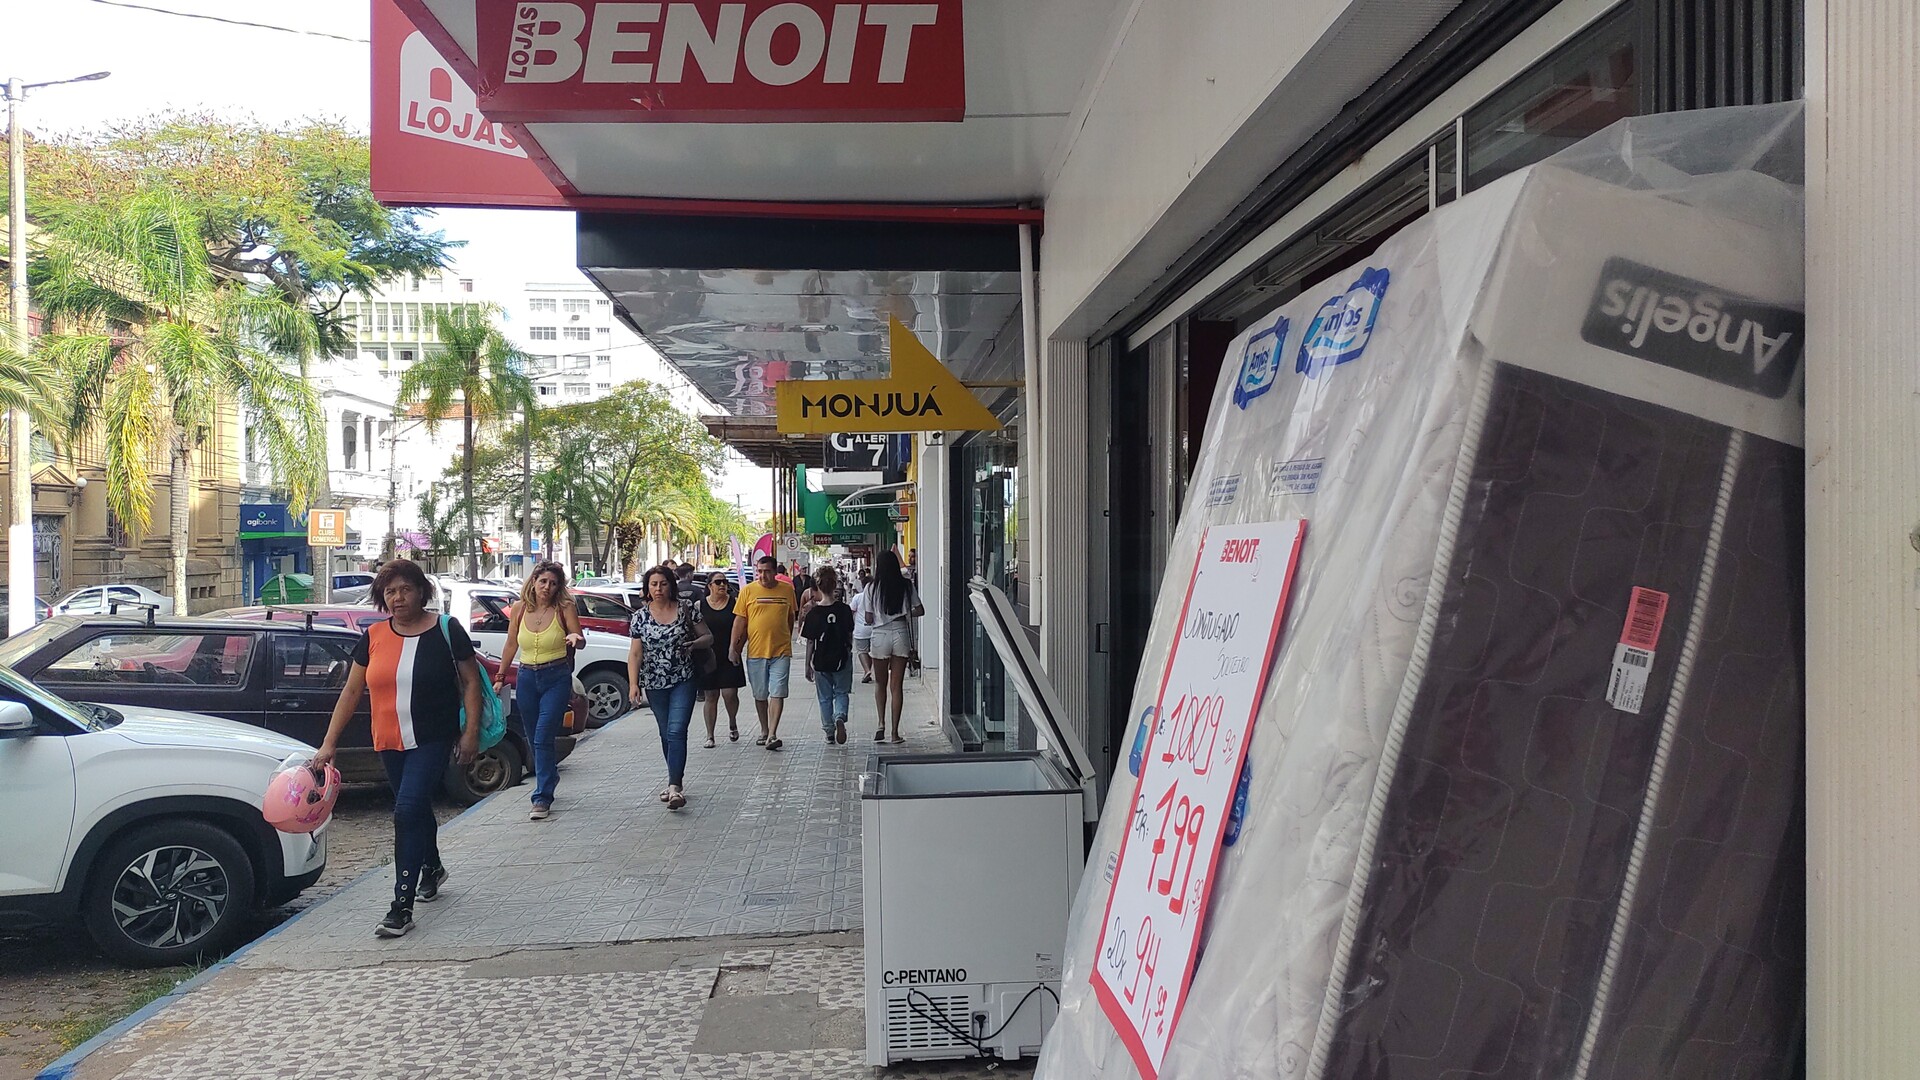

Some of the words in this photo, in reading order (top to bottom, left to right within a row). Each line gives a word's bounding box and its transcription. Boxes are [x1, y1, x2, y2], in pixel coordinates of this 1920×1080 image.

[503, 2, 939, 86] BENOIT
[507, 6, 538, 78] LOJAS
[1601, 279, 1793, 375] Angelis
[802, 385, 943, 418] MONJUÁ
[867, 443, 885, 466] 7
[246, 518, 278, 527] agibank
[840, 511, 869, 527] TOTAL
[311, 535, 342, 543] COMERCIAL
[789, 539, 795, 547] E
[1220, 538, 1260, 563] BENOIT
[883, 968, 968, 985] C-PENTANO
